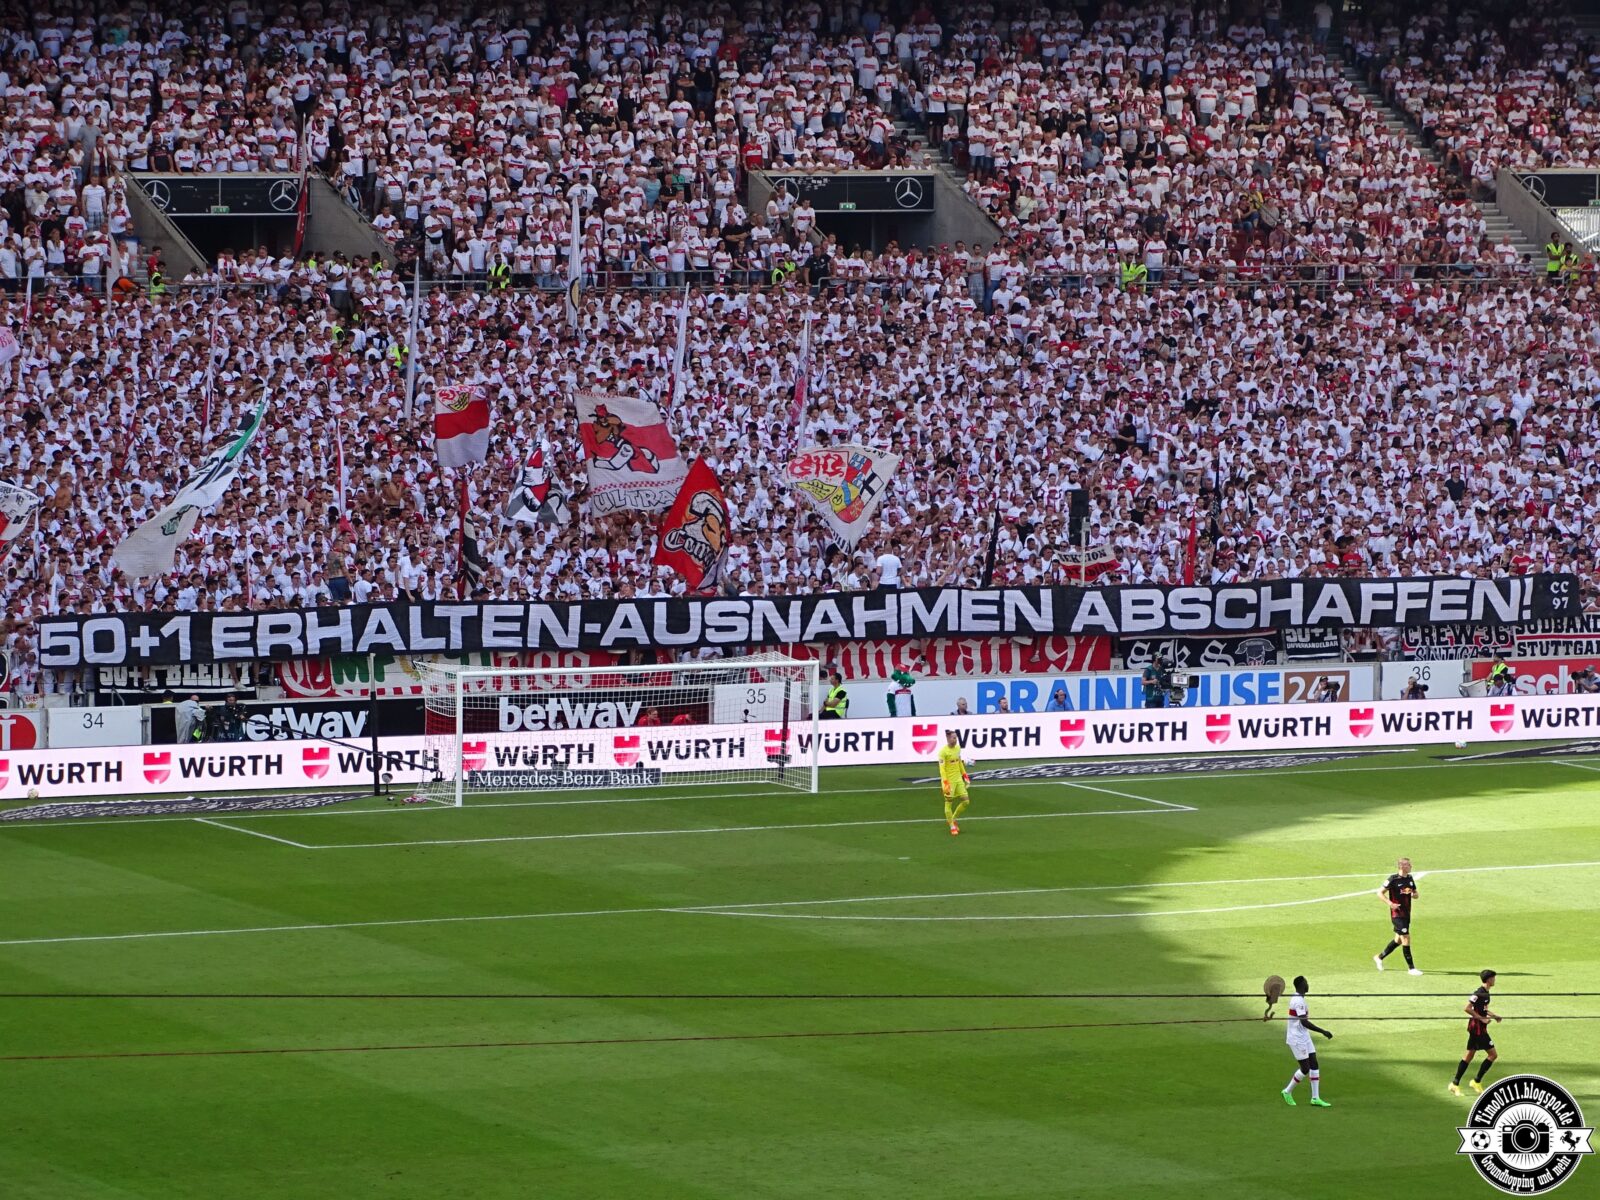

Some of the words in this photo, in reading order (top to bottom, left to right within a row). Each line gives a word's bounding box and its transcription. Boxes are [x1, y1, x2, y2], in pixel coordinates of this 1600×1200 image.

[593, 487, 681, 513] ULTRA
[1550, 581, 1569, 594] CC
[1552, 596, 1569, 610] 97
[40, 615, 191, 666] 50+1
[212, 588, 1054, 659] ERHALTEN-AUSNAHMEN
[1071, 576, 1534, 632] ABSCHAFFEN!
[1517, 640, 1600, 657] STUTTGA
[1411, 665, 1431, 682] 36
[746, 688, 767, 704] 35
[83, 713, 104, 729] 34
[498, 696, 643, 732] betway
[1521, 706, 1600, 728] WÜRT
[476, 771, 604, 787] Mercedes-Benz
[609, 769, 653, 785] Bank
